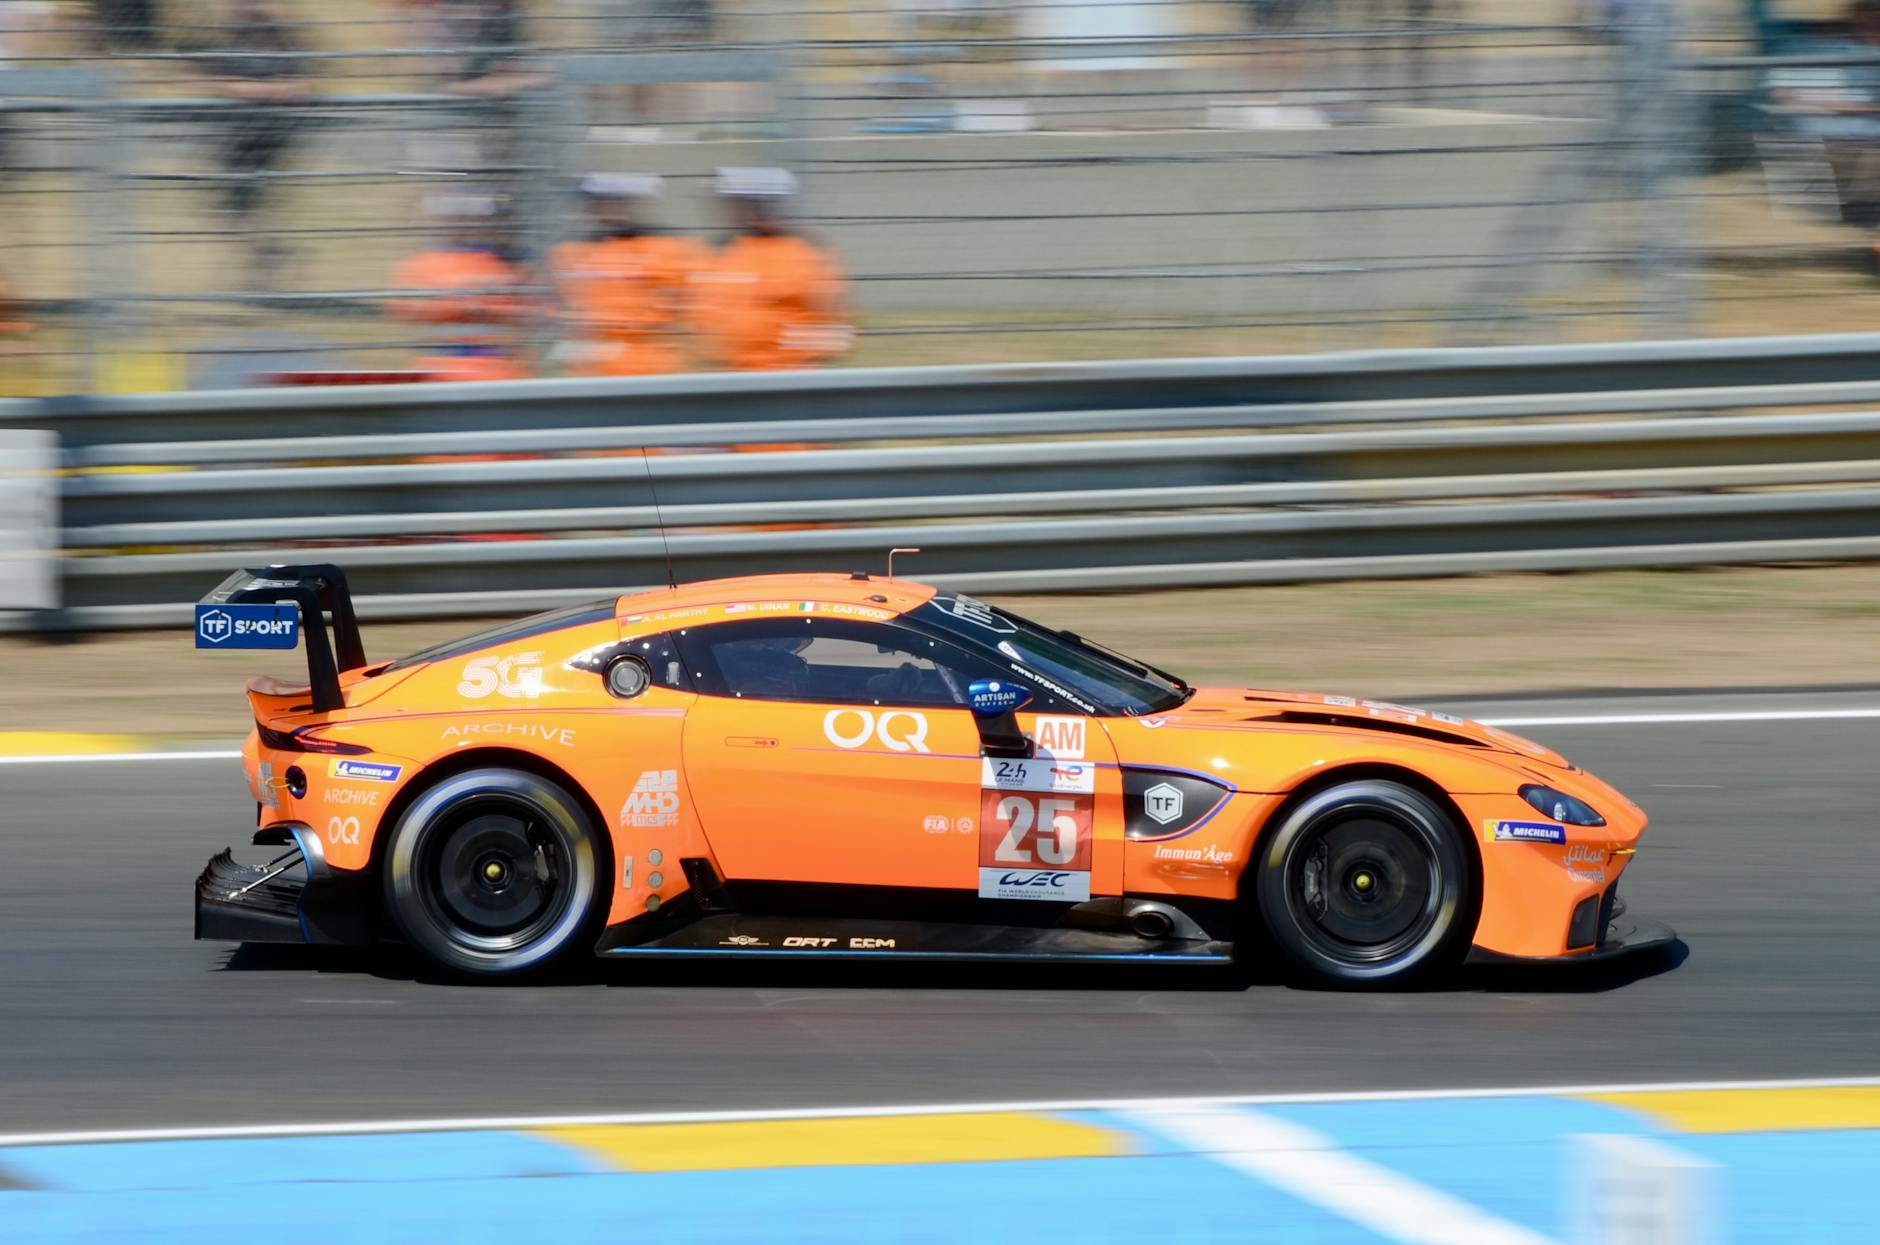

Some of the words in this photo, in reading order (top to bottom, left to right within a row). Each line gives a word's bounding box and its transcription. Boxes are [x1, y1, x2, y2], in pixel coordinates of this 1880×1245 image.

[833, 604, 888, 618] EASTWOOD
[204, 620, 227, 634] TF
[234, 620, 294, 634] SPORT
[974, 692, 1016, 702] ARTISAN
[441, 722, 577, 748] ARCHIVE
[824, 710, 932, 752] OQ
[1038, 722, 1082, 751] AM
[349, 766, 393, 777] MICHELIN
[324, 788, 379, 806] ARCHIVE
[1152, 797, 1175, 810] TF
[328, 816, 360, 845] OQ
[924, 818, 946, 832] FIA
[994, 796, 1077, 864] 25
[1513, 827, 1560, 838] MICHELIN
[998, 872, 1072, 888] WEC
